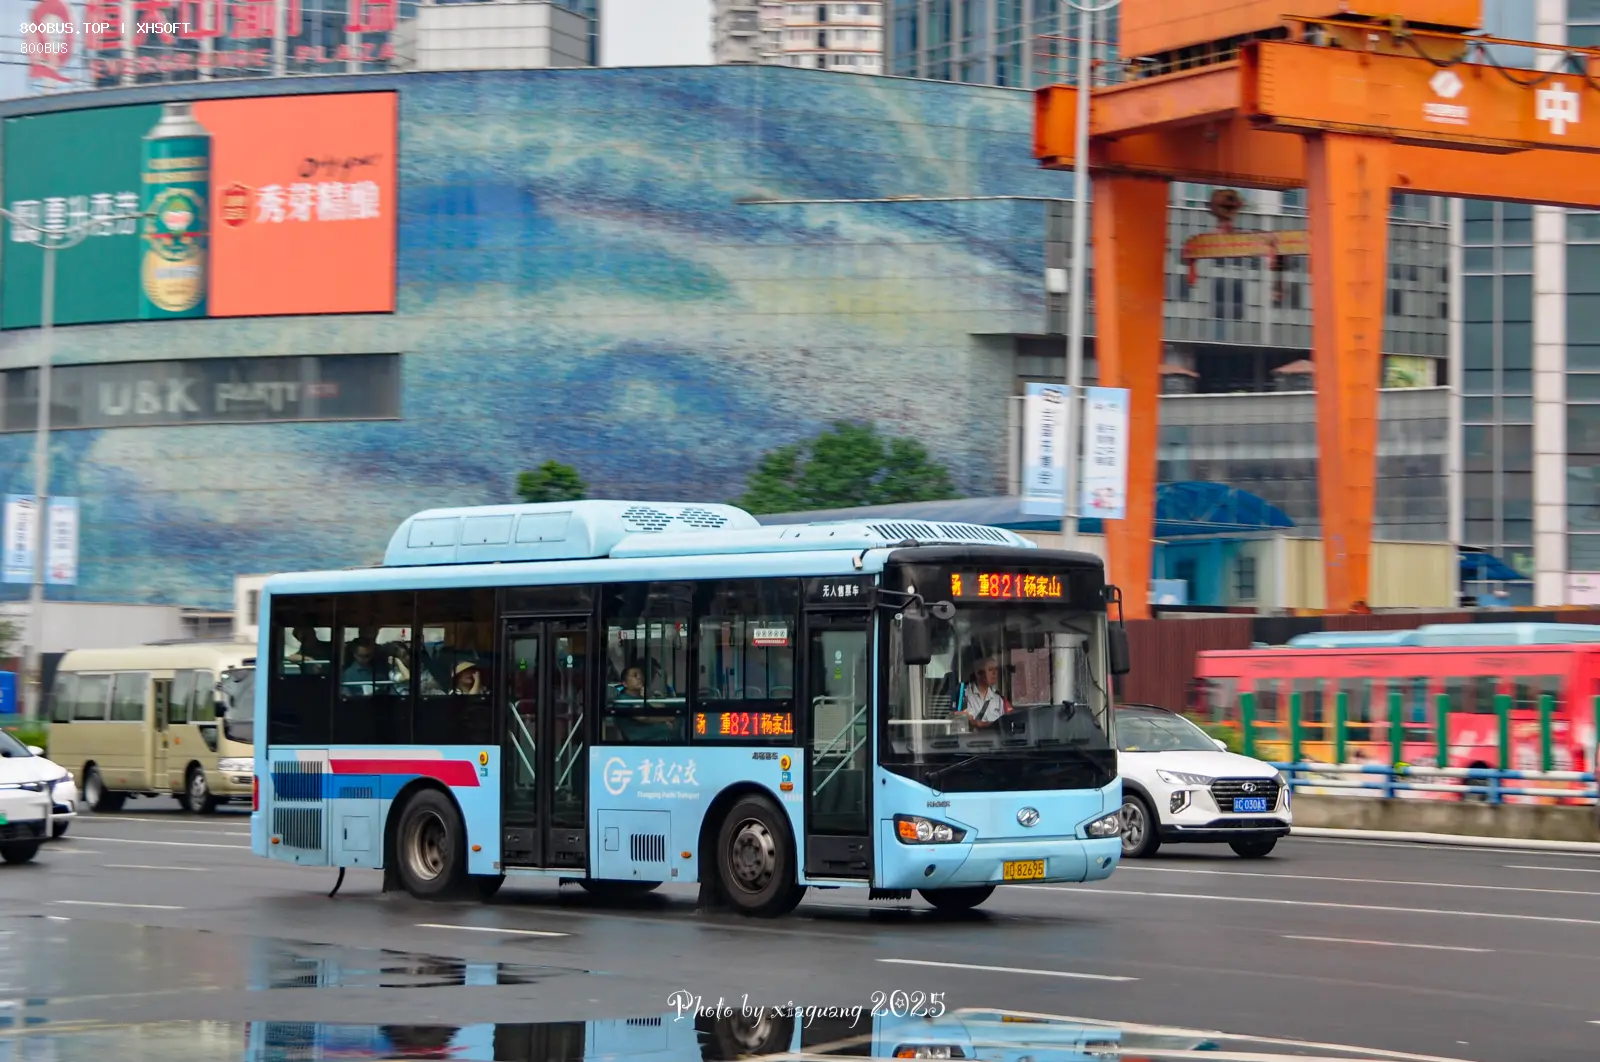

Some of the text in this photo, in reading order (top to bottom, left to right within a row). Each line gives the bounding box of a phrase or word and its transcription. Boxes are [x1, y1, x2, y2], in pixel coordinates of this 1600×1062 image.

[294, 43, 397, 64] PLAZA
[1535, 82, 1580, 135] 中
[637, 758, 700, 787] 重庆公交
